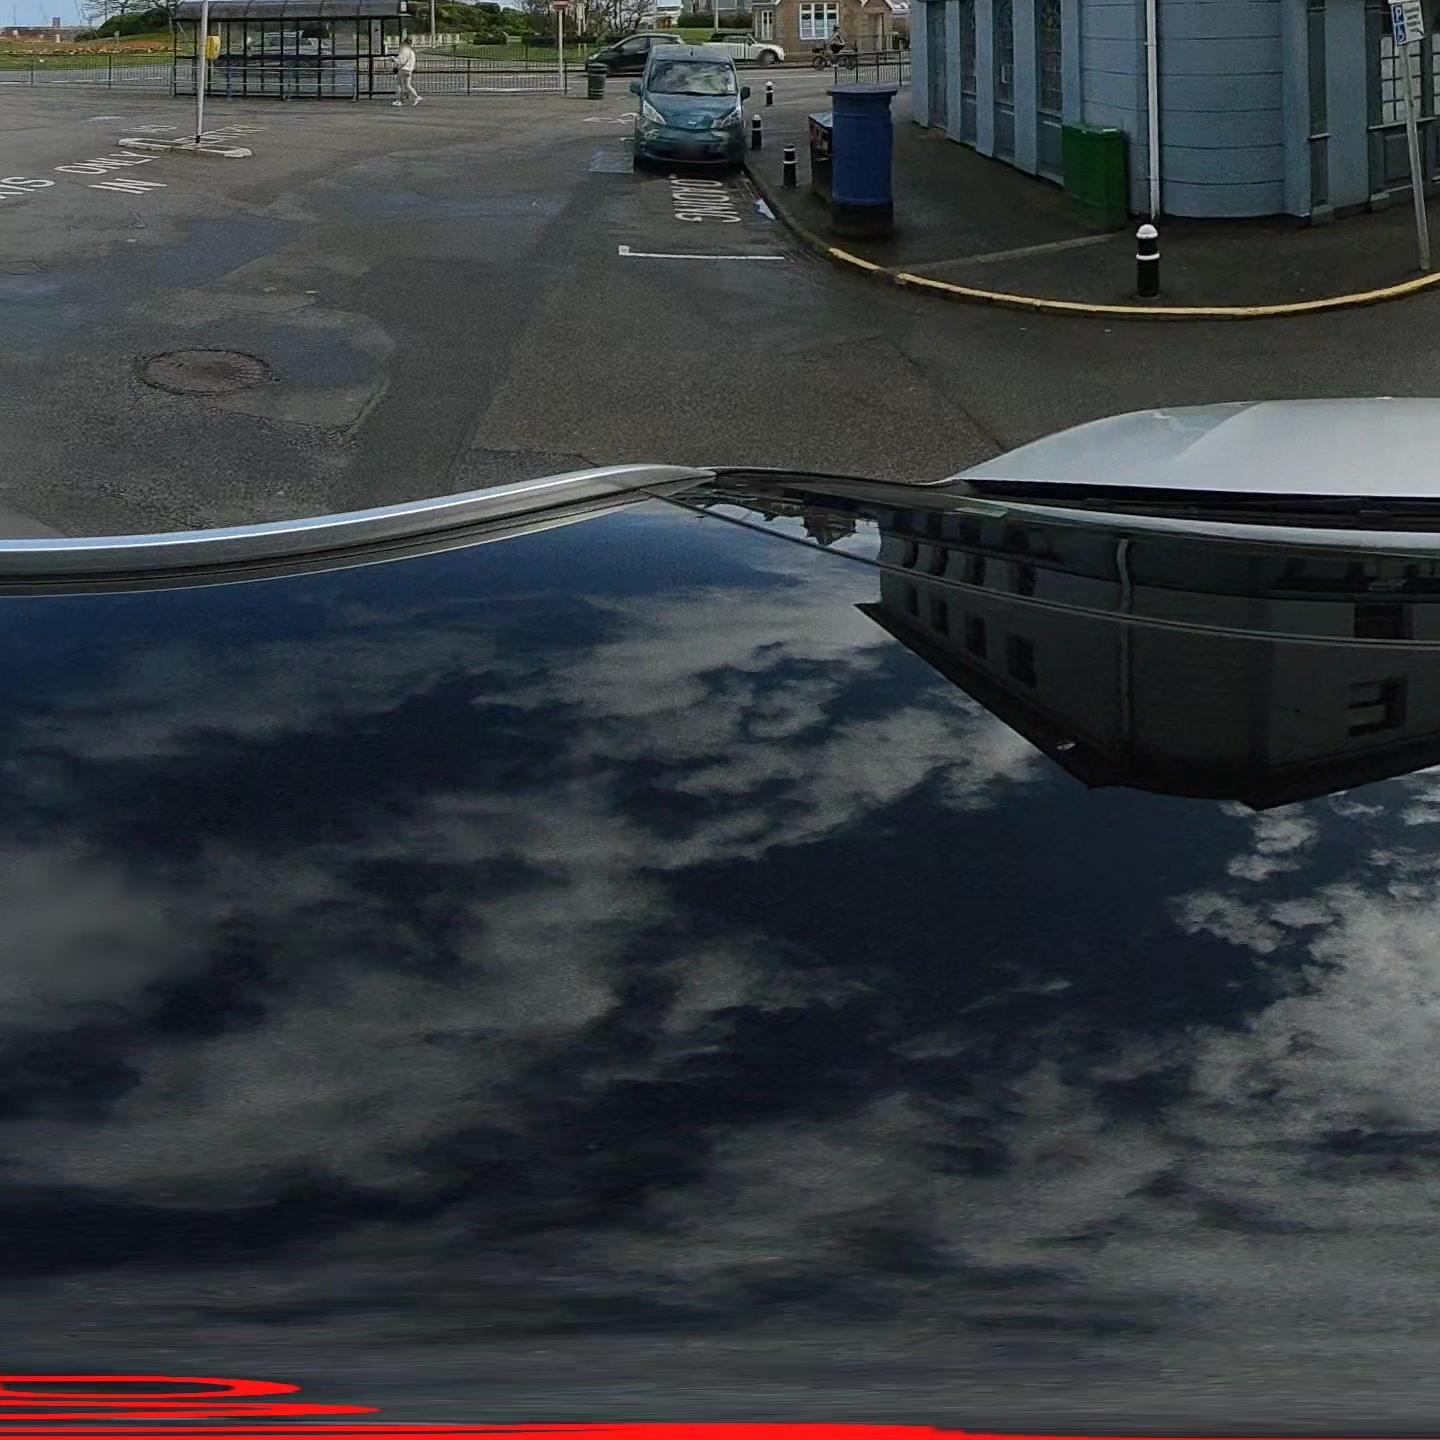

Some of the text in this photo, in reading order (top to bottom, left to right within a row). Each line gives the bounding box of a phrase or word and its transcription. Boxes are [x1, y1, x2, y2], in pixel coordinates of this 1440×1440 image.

[54, 150, 161, 176] ONLY
[89, 178, 168, 195] IN
[669, 174, 742, 222] OADING
